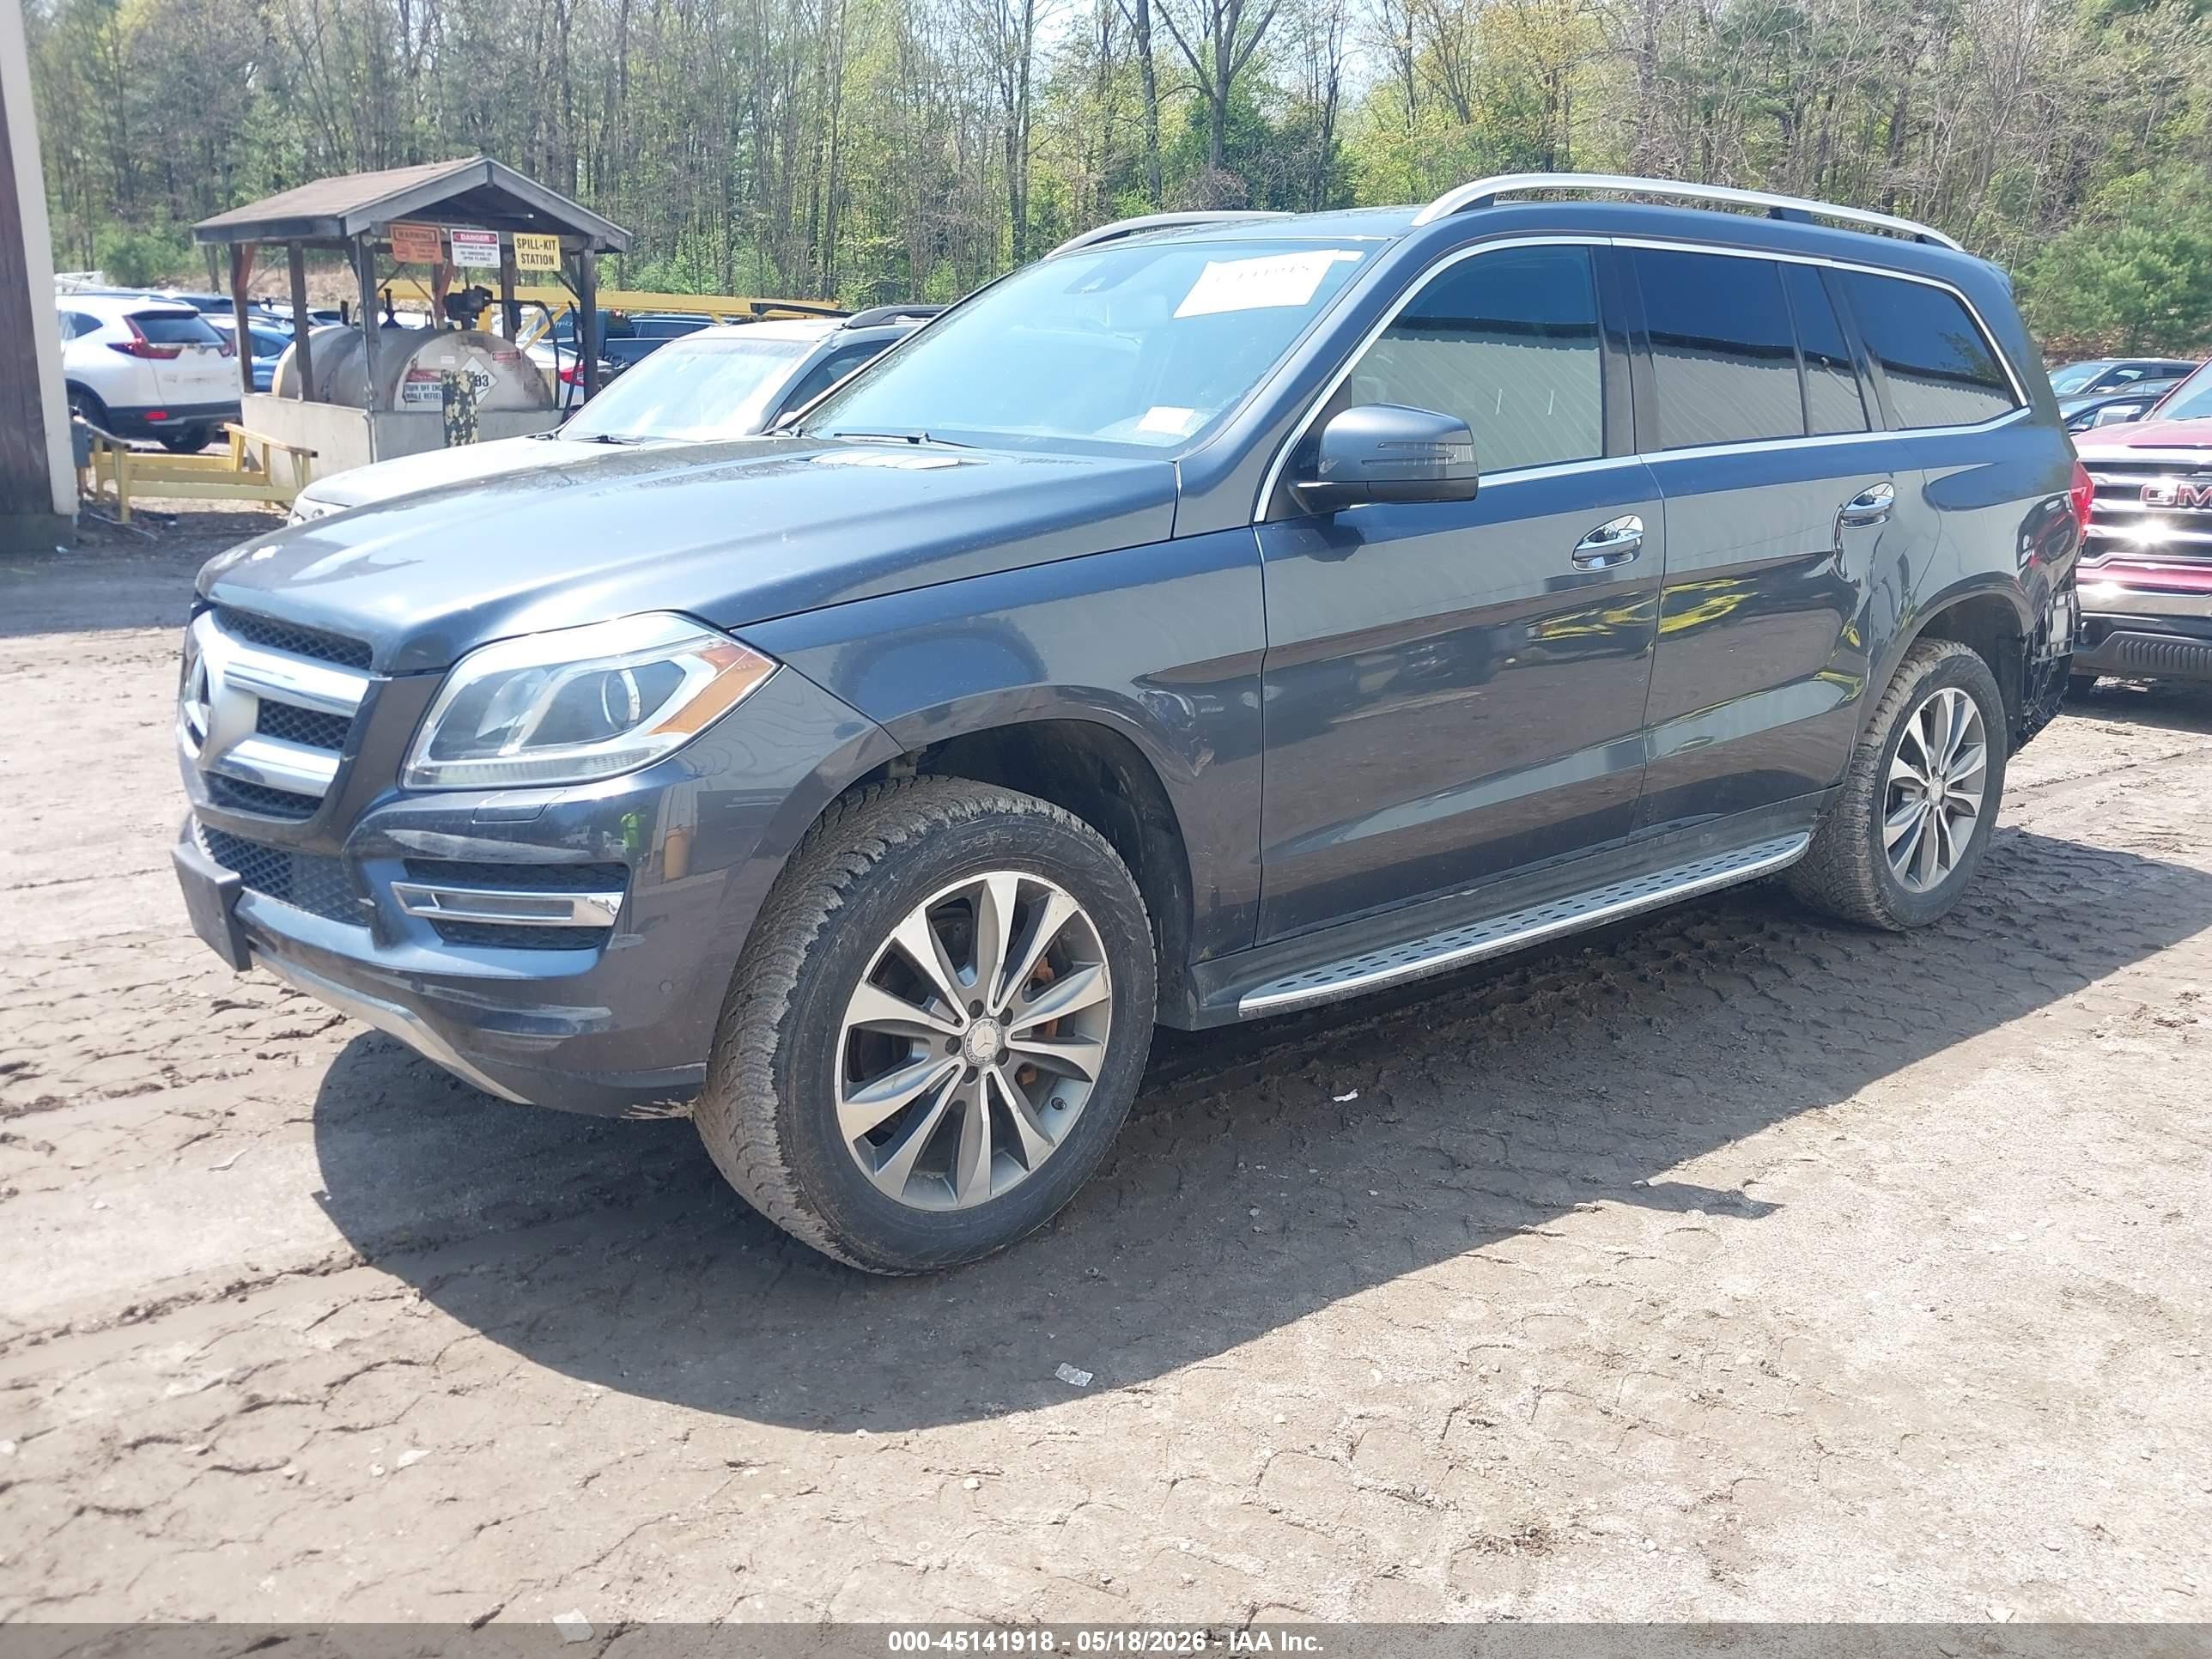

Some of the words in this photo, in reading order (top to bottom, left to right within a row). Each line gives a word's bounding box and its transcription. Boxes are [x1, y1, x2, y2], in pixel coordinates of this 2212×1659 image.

[460, 233, 489, 242] DANGER
[516, 237, 556, 251] SPILL-KIT
[520, 252, 555, 265] STATION
